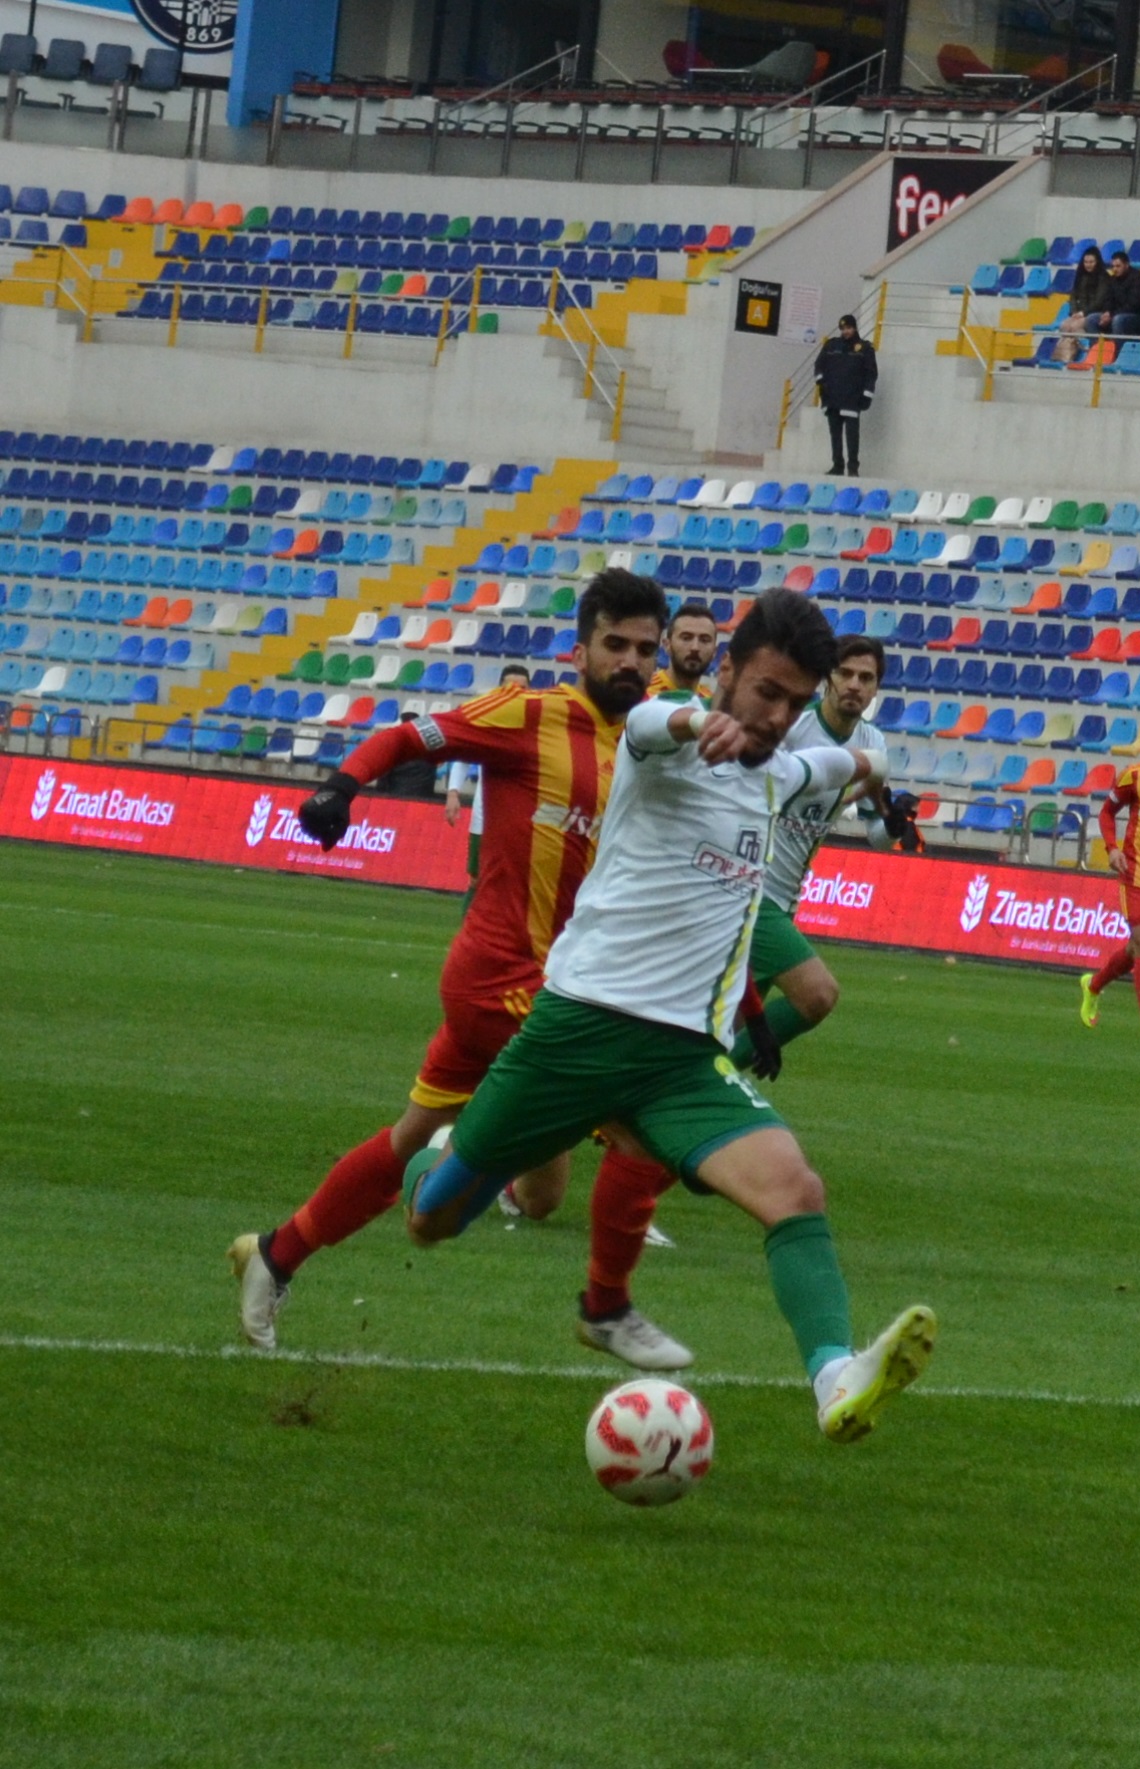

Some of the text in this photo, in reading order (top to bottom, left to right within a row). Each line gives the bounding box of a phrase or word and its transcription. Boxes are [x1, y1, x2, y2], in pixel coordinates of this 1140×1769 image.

[182, 26, 222, 42] 869
[54, 783, 175, 826] Ziraat Bankası
[989, 890, 1131, 939] Ziraat Bankas
